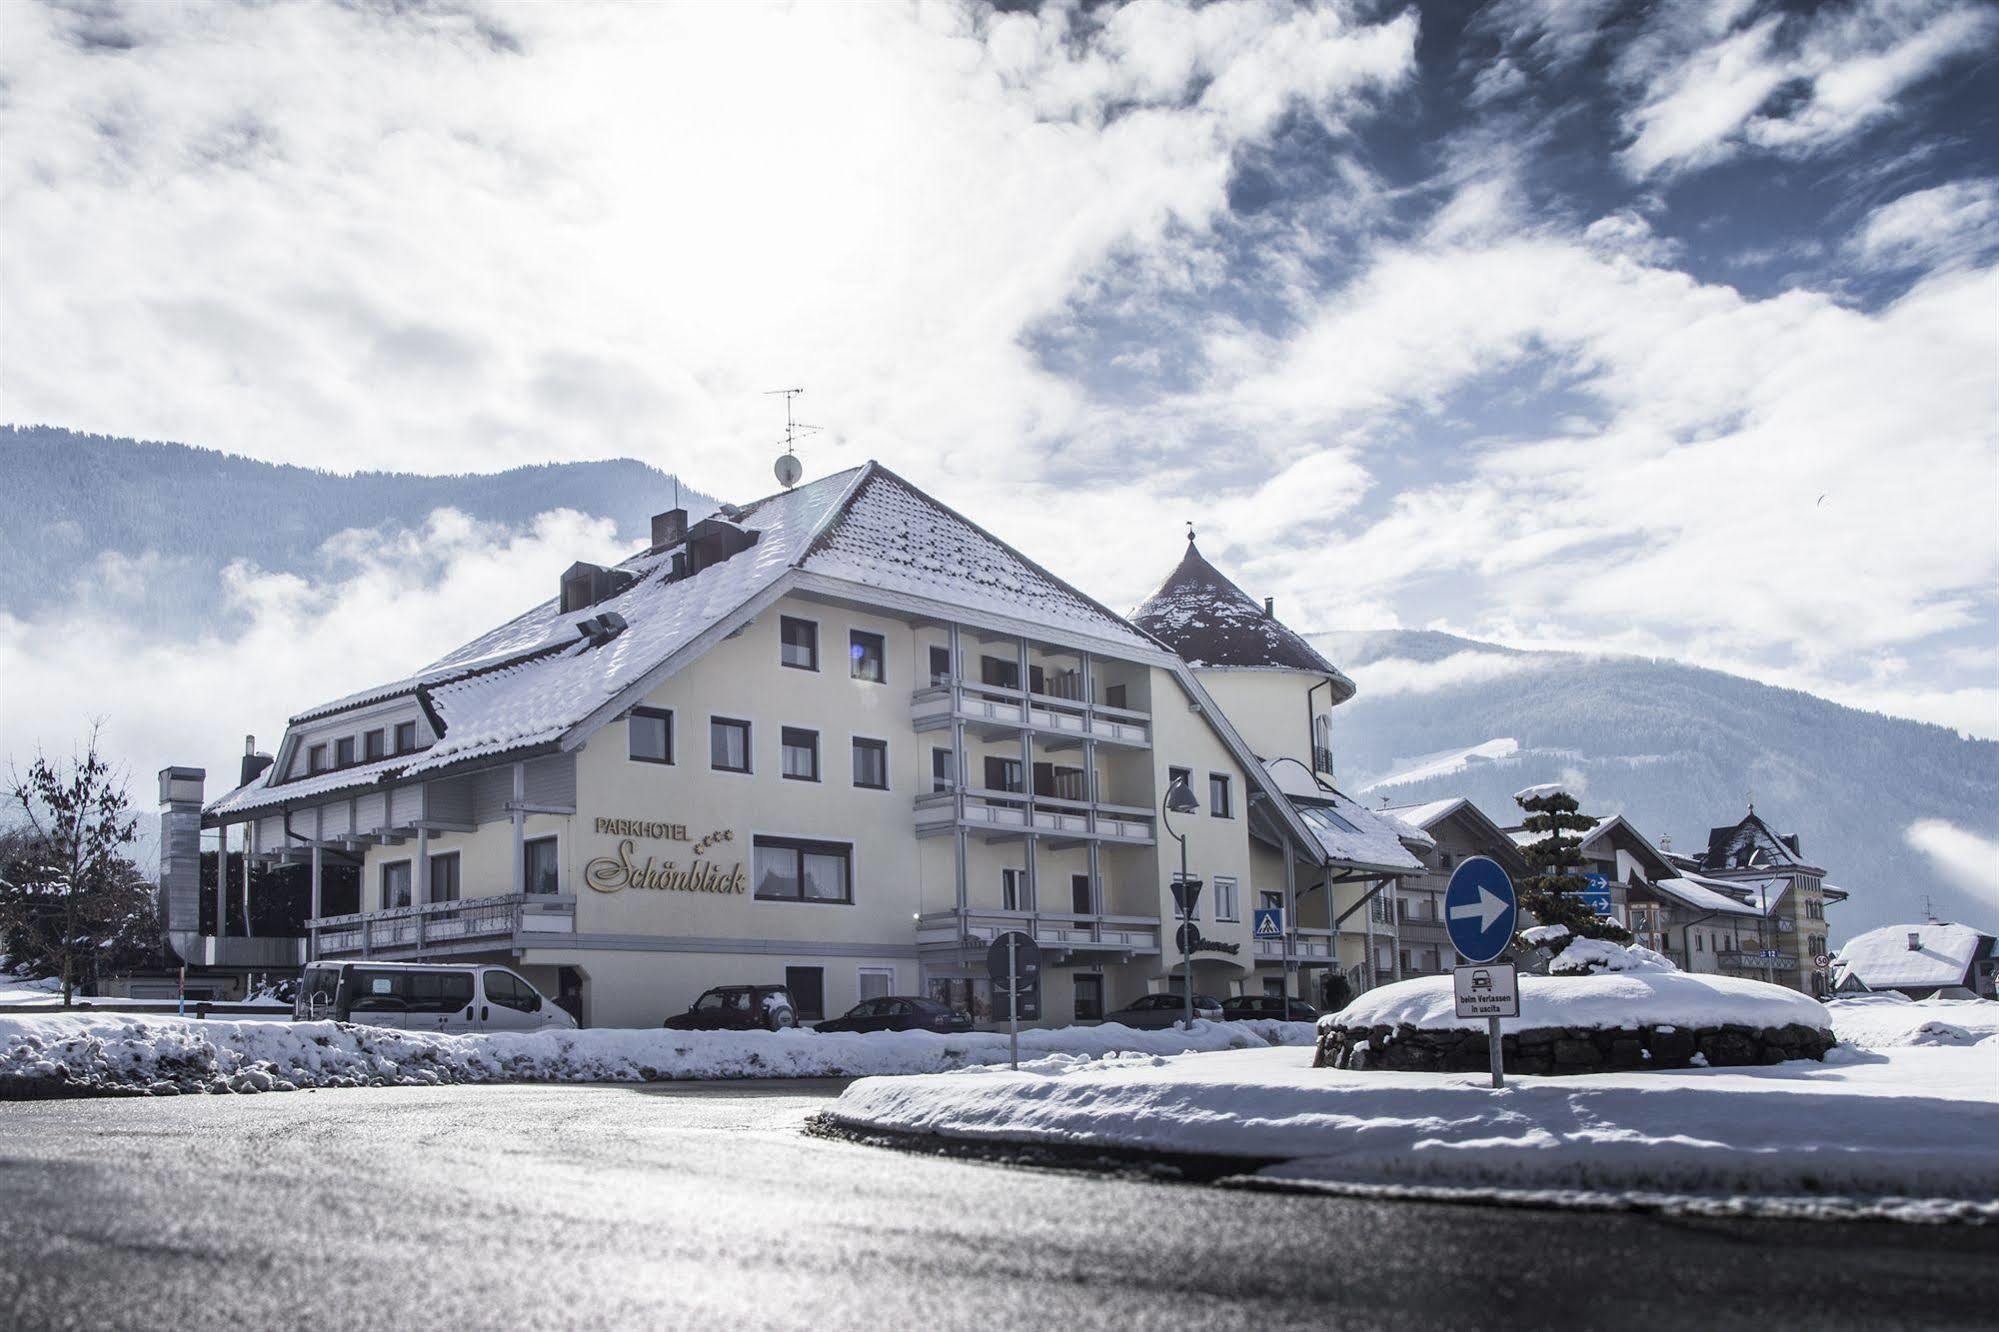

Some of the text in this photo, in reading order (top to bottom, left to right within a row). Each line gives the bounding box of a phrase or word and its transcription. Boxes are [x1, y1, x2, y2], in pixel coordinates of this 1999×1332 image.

[596, 816, 692, 842] PARKHOTEL
[585, 839, 746, 894] Schönblick
[1478, 994, 1511, 1003] Verlassen
